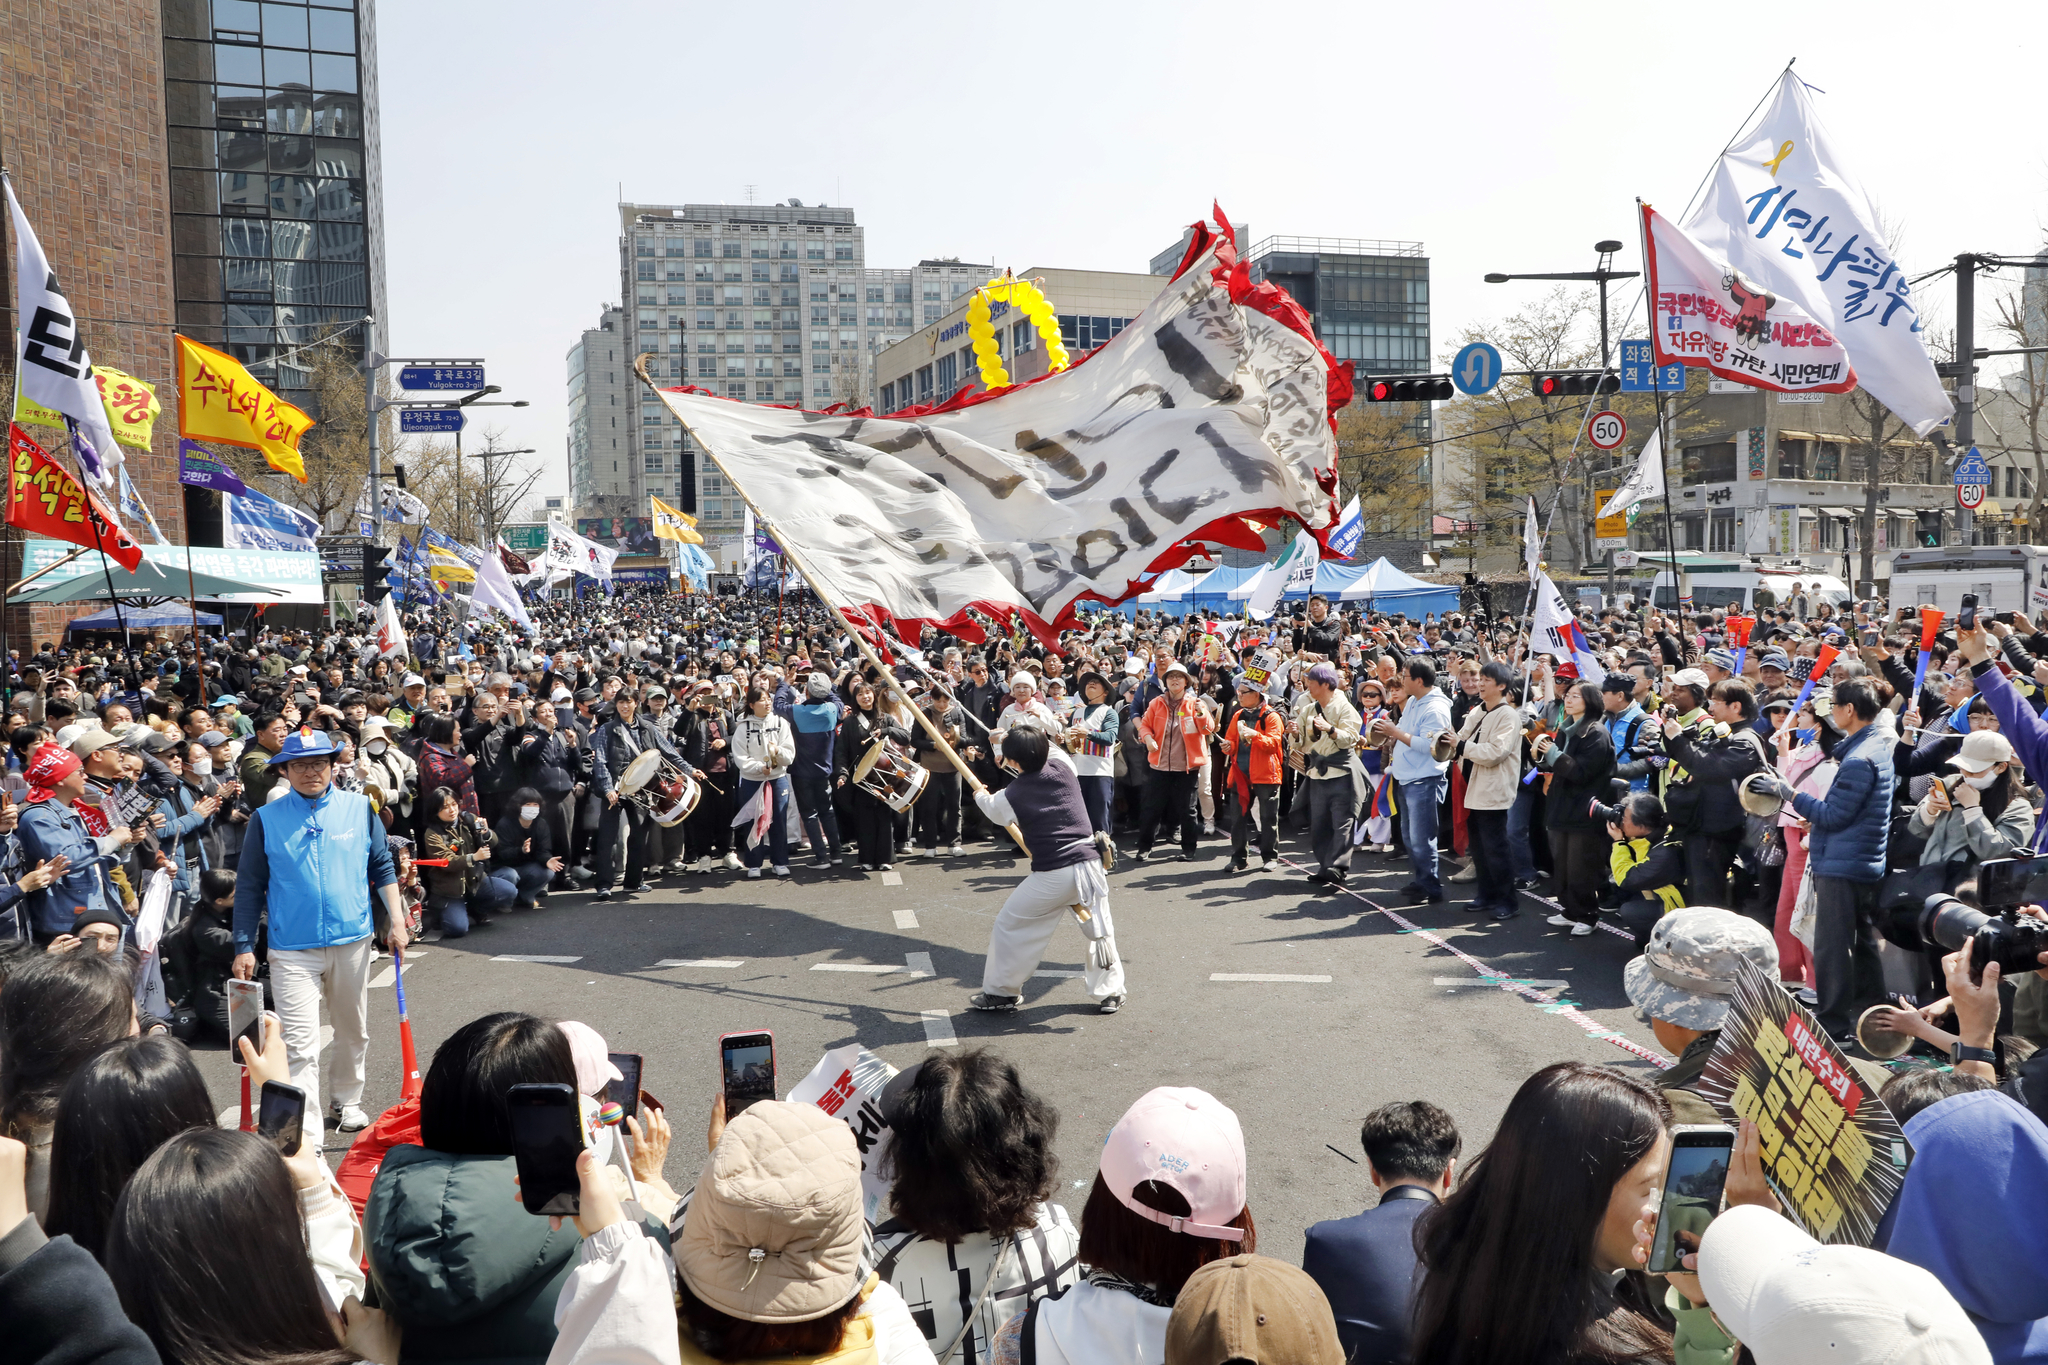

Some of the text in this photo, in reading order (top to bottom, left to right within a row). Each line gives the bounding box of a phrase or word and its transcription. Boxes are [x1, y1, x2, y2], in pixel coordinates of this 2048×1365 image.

[1668, 331, 1729, 362] 자유한당
[1730, 348, 1766, 374] 규탄
[1769, 362, 1841, 385] 시민연대
[433, 370, 482, 381] 율곡로3길
[428, 381, 482, 390] Yulgok-ro 3-gil
[403, 412, 442, 423] 우정국로
[403, 424, 453, 432] Ujeongguk-ro
[1595, 422, 1619, 439] 50
[186, 449, 221, 464] 페미니
[181, 471, 212, 483] 구한다
[14, 450, 86, 524] 윤석열
[1963, 485, 1979, 502] 50
[1601, 539, 1622, 547] 300m
[175, 552, 237, 577] 윤석열을
[236, 555, 266, 578] 즉각
[264, 556, 318, 579] 파면하라!
[1244, 666, 1267, 682] 하라
[1791, 1022, 1851, 1101] 내란수괴
[1754, 1017, 1873, 1185] 윤석열을
[1159, 1153, 1190, 1170] ADER
[1729, 1074, 1844, 1242] 파면하라
